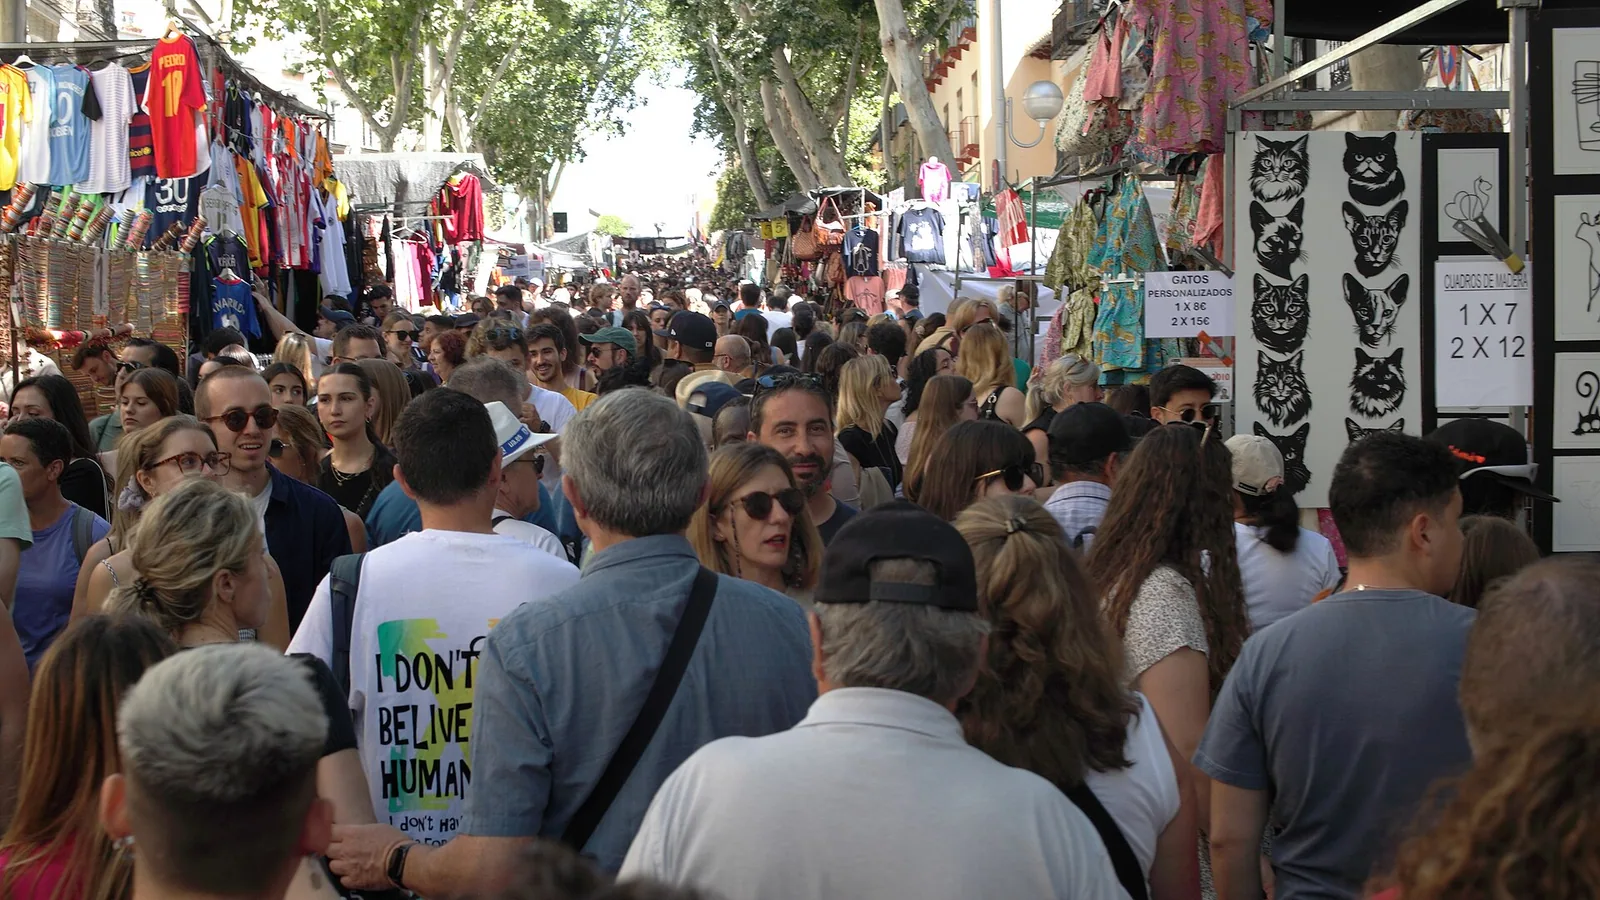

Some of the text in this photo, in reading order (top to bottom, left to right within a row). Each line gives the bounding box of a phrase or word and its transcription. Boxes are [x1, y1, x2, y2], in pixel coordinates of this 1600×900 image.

[158, 54, 186, 69] PEDRO
[162, 70, 183, 117] 10
[155, 177, 189, 204] 30
[1172, 275, 1209, 284] GATOS
[1444, 273, 1528, 289] CUADROS DE MADERA
[1148, 289, 1233, 297] PERSONALIZADOS
[1175, 302, 1207, 311] 1 X 8€
[1459, 303, 1518, 325] 1 X 7
[1171, 317, 1210, 326] 2 X 15€
[1451, 336, 1525, 359] 2 X 12
[375, 649, 481, 694] I DON'T
[378, 702, 472, 750] BELIVE
